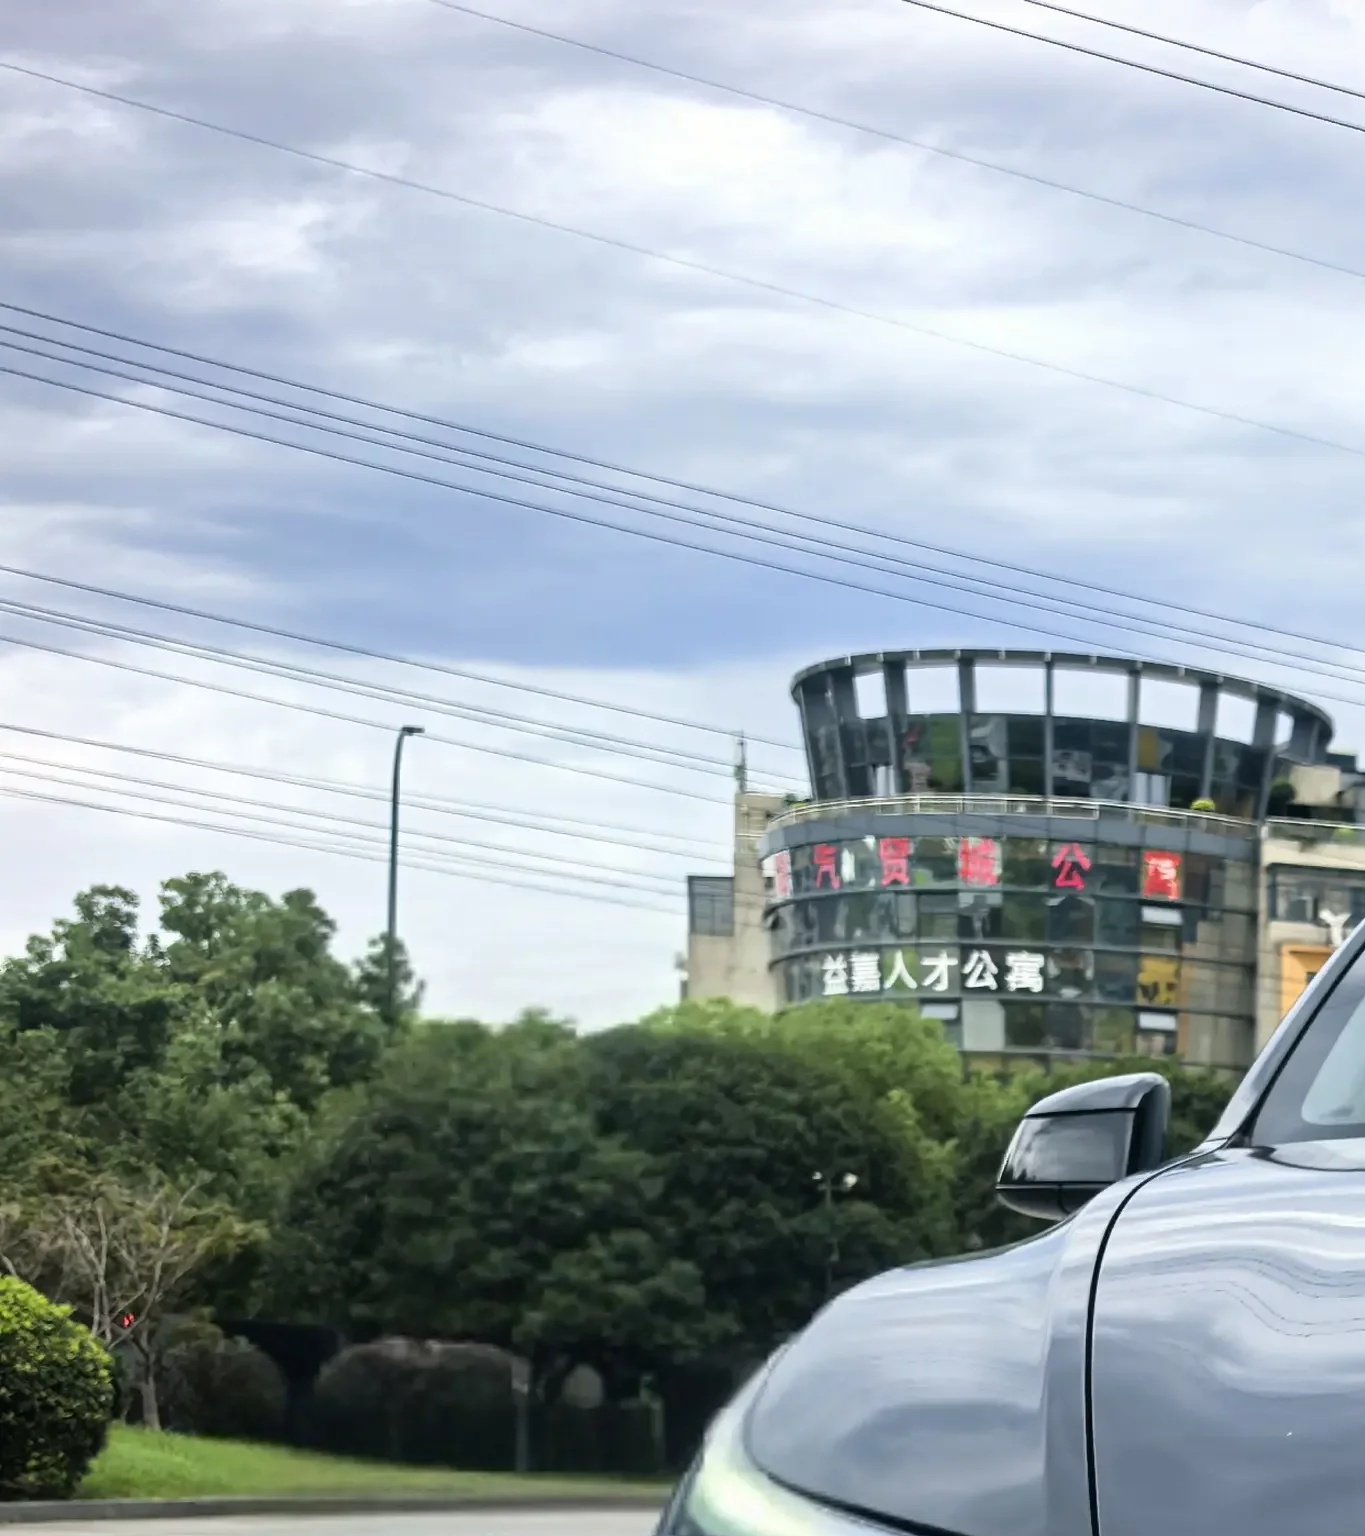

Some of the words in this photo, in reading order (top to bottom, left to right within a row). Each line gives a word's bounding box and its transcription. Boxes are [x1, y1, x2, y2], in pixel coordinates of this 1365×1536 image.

[821, 950, 1045, 995] 益嘉人才公寓
